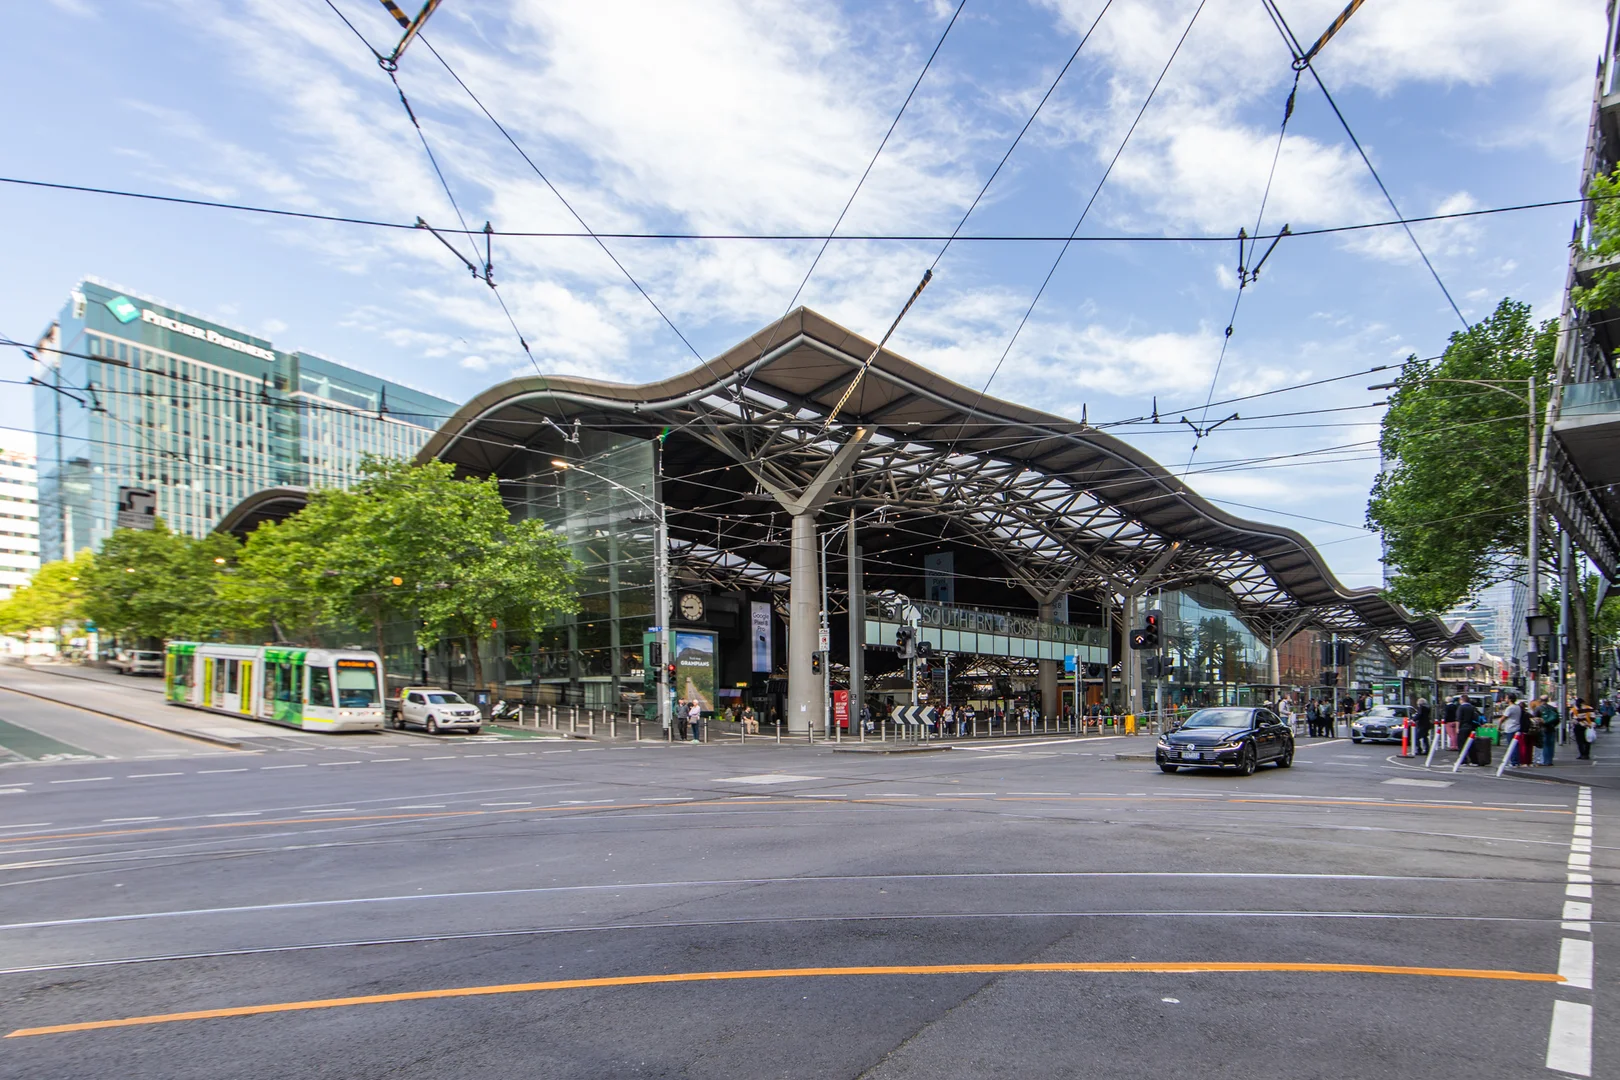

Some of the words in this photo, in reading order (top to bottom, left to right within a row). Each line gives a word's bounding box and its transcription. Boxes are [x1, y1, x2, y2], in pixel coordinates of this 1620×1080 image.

[142, 309, 208, 341] PITCHER
[207, 329, 275, 362] PARTNERS
[753, 612, 769, 620] Google
[922, 606, 993, 631] SOUTHERN
[998, 617, 1034, 636] CROSS
[1041, 622, 1078, 642] STATION
